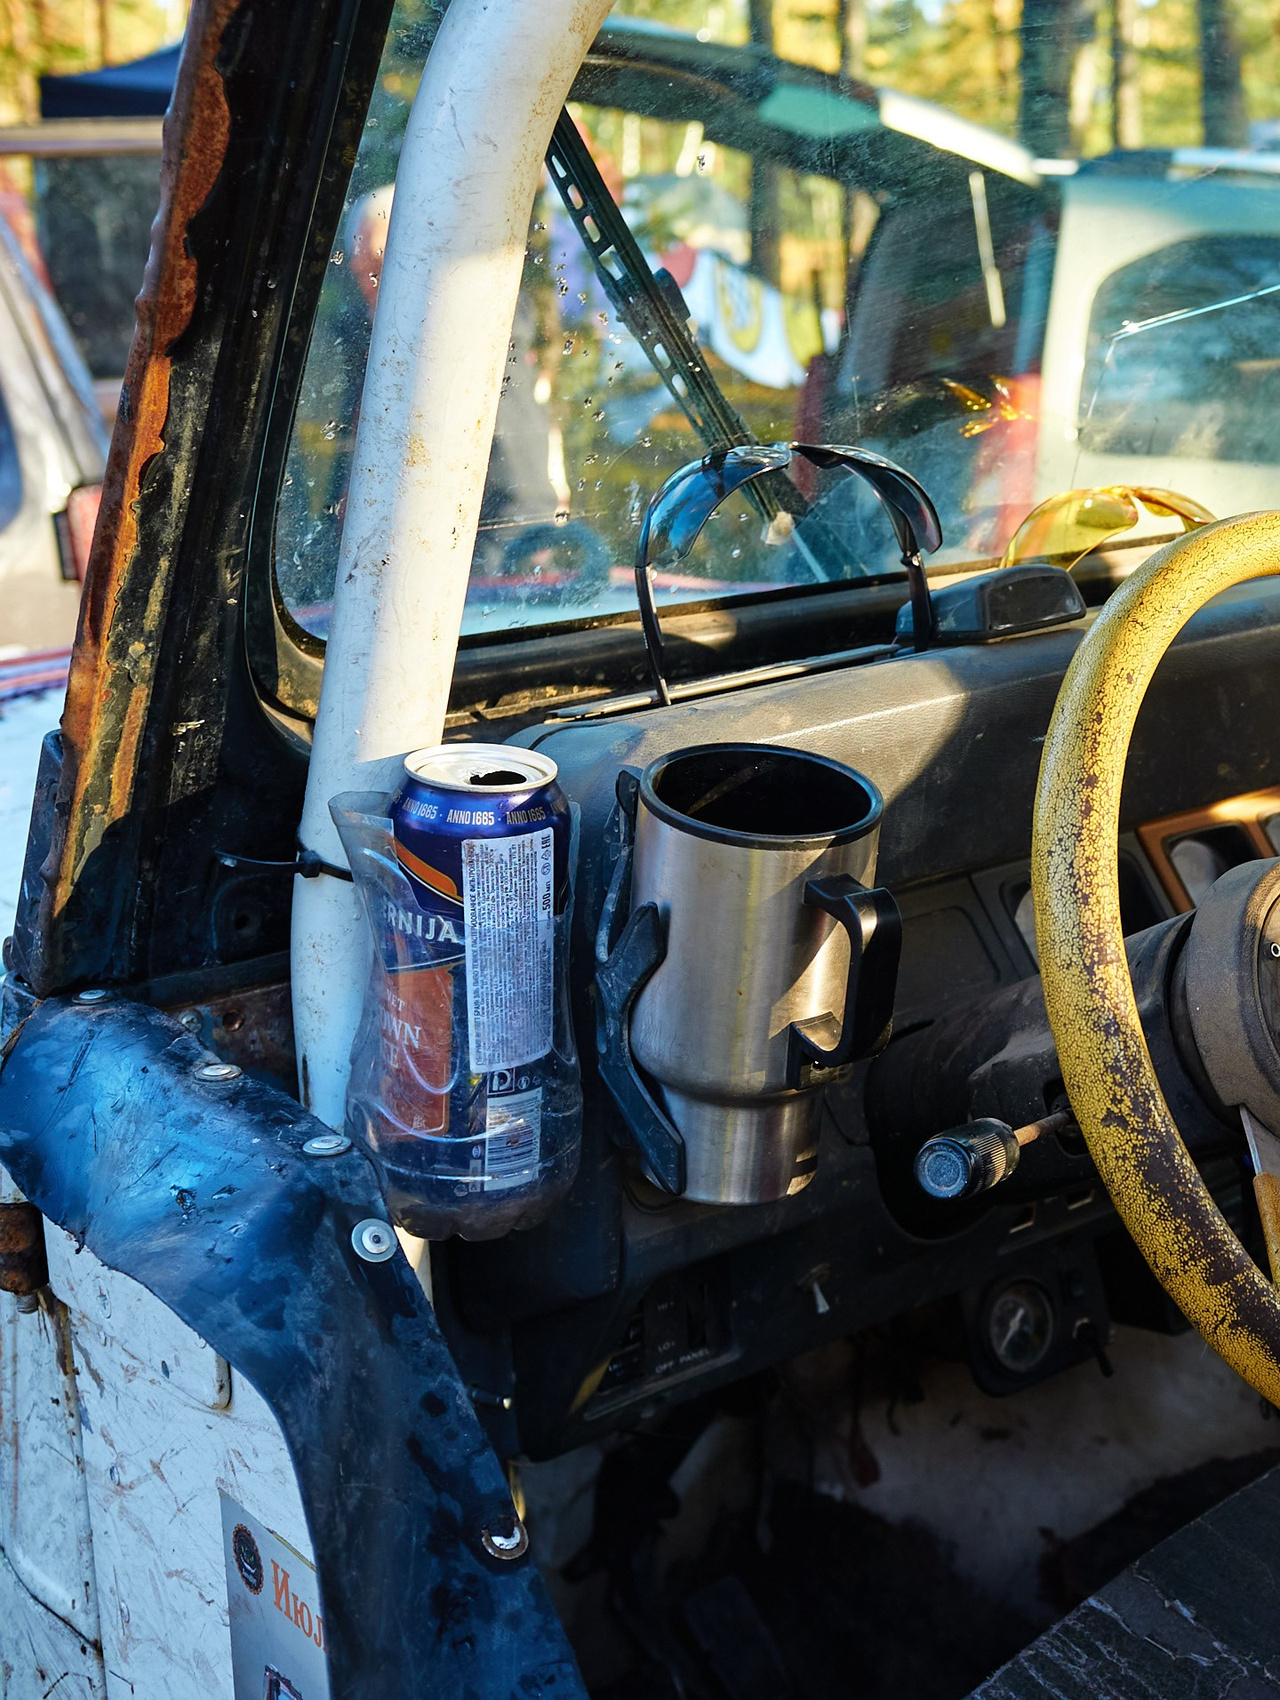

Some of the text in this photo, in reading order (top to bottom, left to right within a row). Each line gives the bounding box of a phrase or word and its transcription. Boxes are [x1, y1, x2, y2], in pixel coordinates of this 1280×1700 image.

[402, 797, 419, 815] ANNO
[417, 803, 439, 820] 1665
[446, 809, 471, 825] ANNO
[472, 811, 495, 826] 1665
[506, 810, 528, 825] ANNO
[528, 807, 547, 822] 1665
[542, 893, 551, 911] 500
